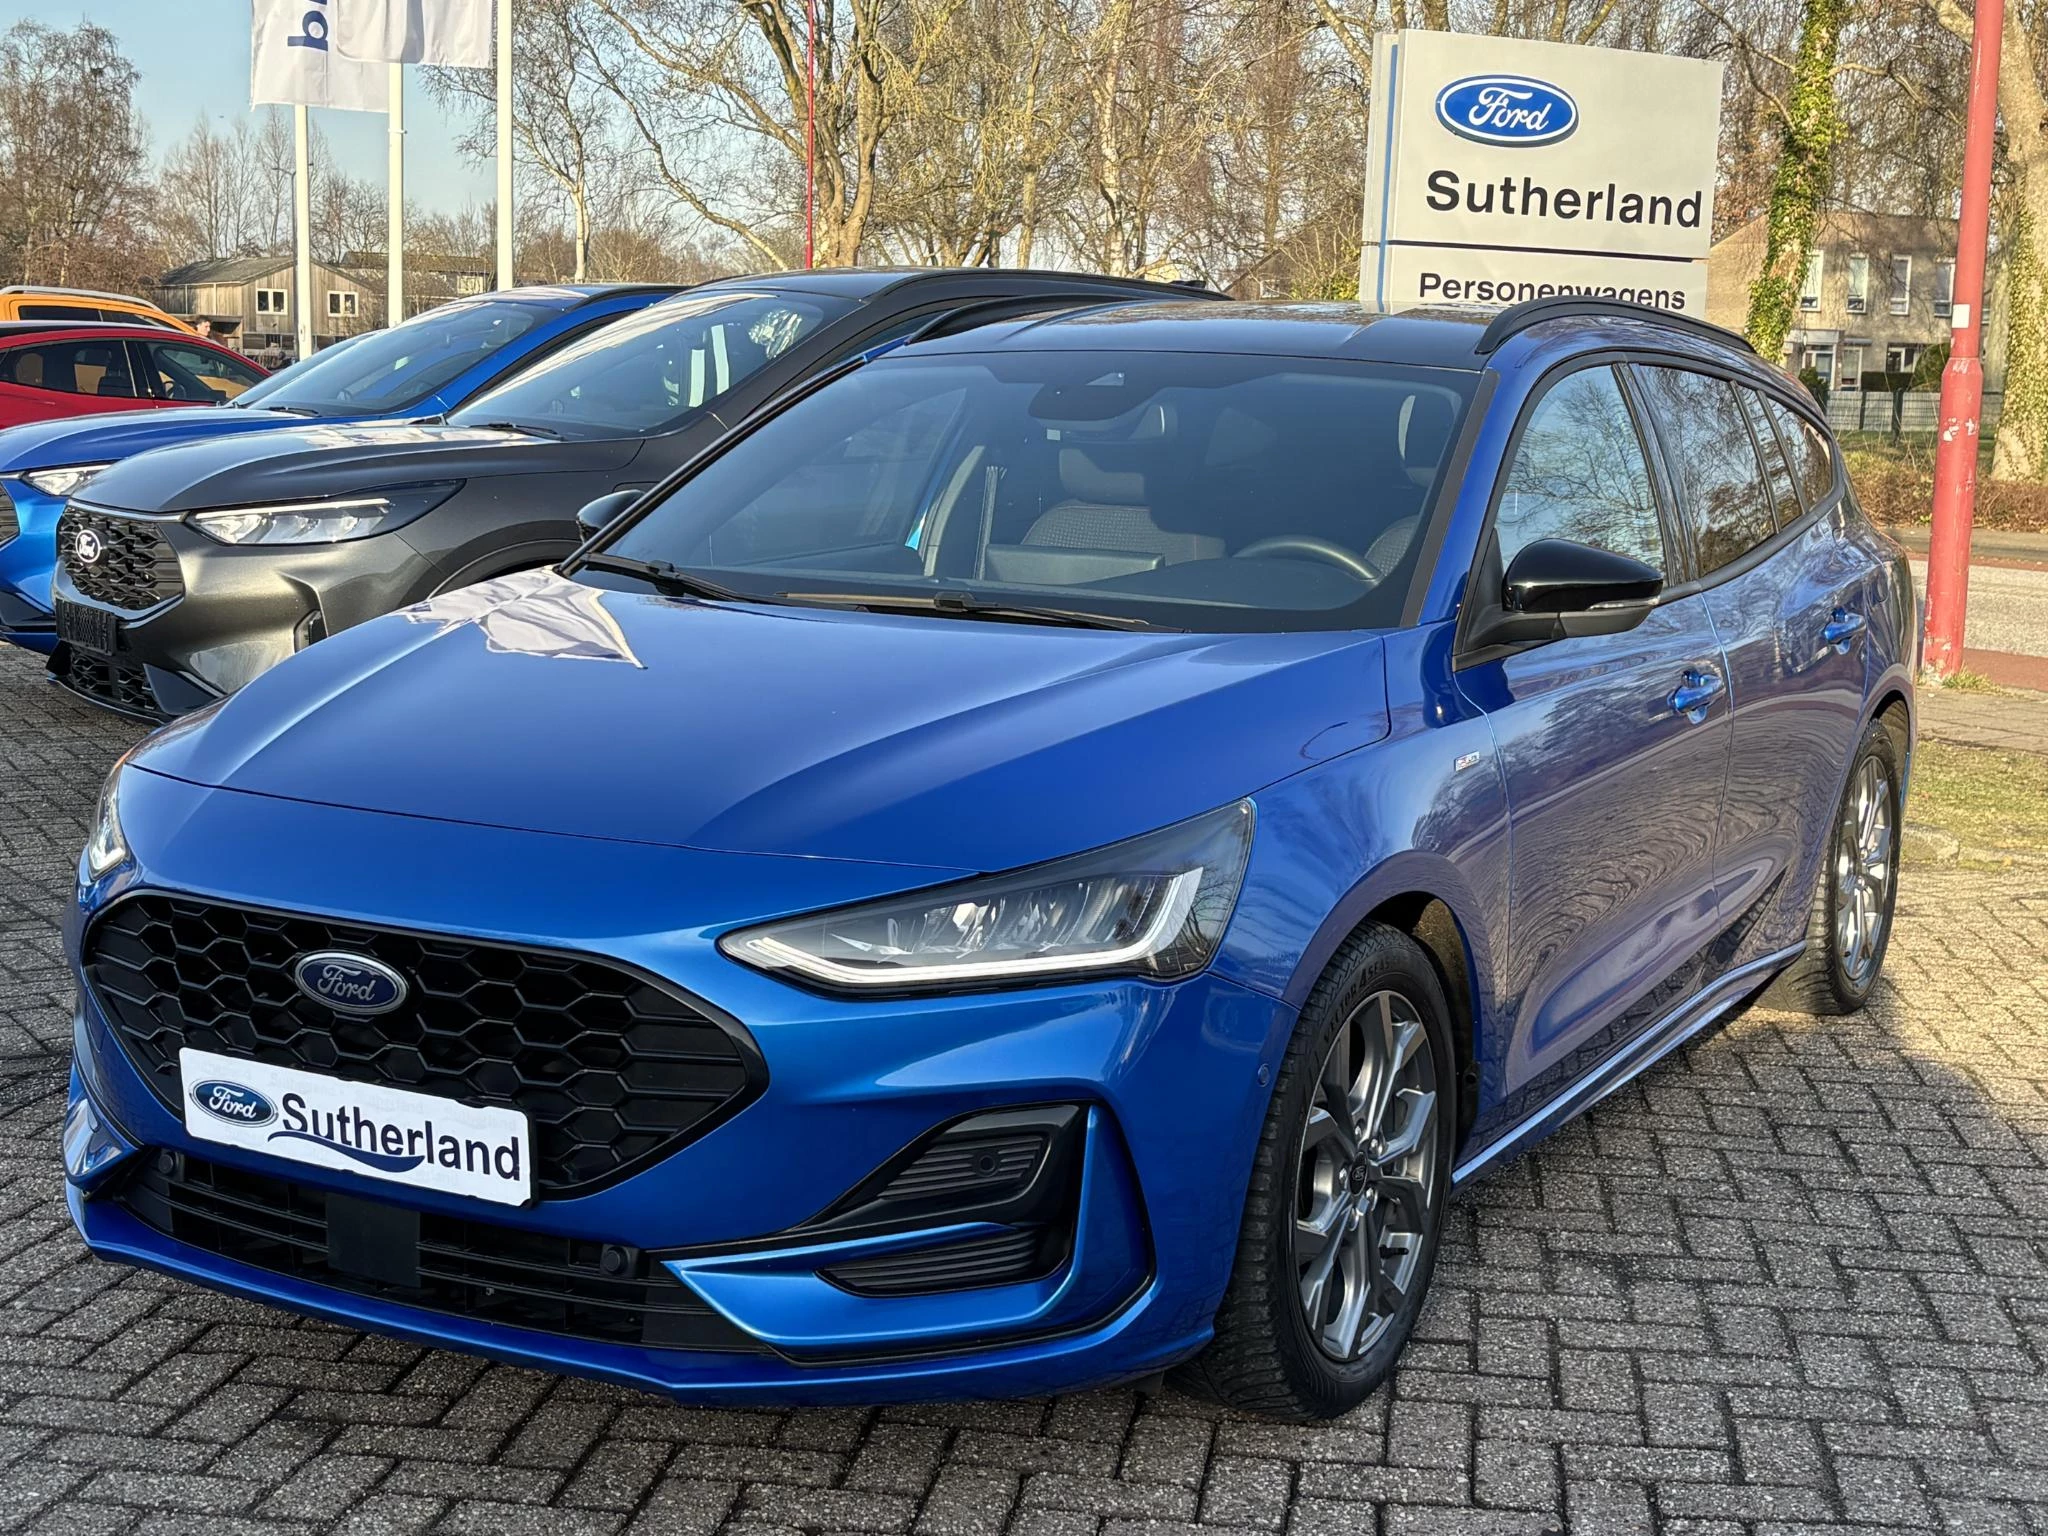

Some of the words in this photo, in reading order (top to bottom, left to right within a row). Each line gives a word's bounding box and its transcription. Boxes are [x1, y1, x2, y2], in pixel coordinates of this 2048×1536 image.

[1467, 86, 1554, 132] Ford
[1425, 169, 1703, 229] Sutherland
[315, 963, 377, 1002] Ford
[208, 1084, 257, 1120] Ford
[282, 1092, 522, 1182] Sutherland
